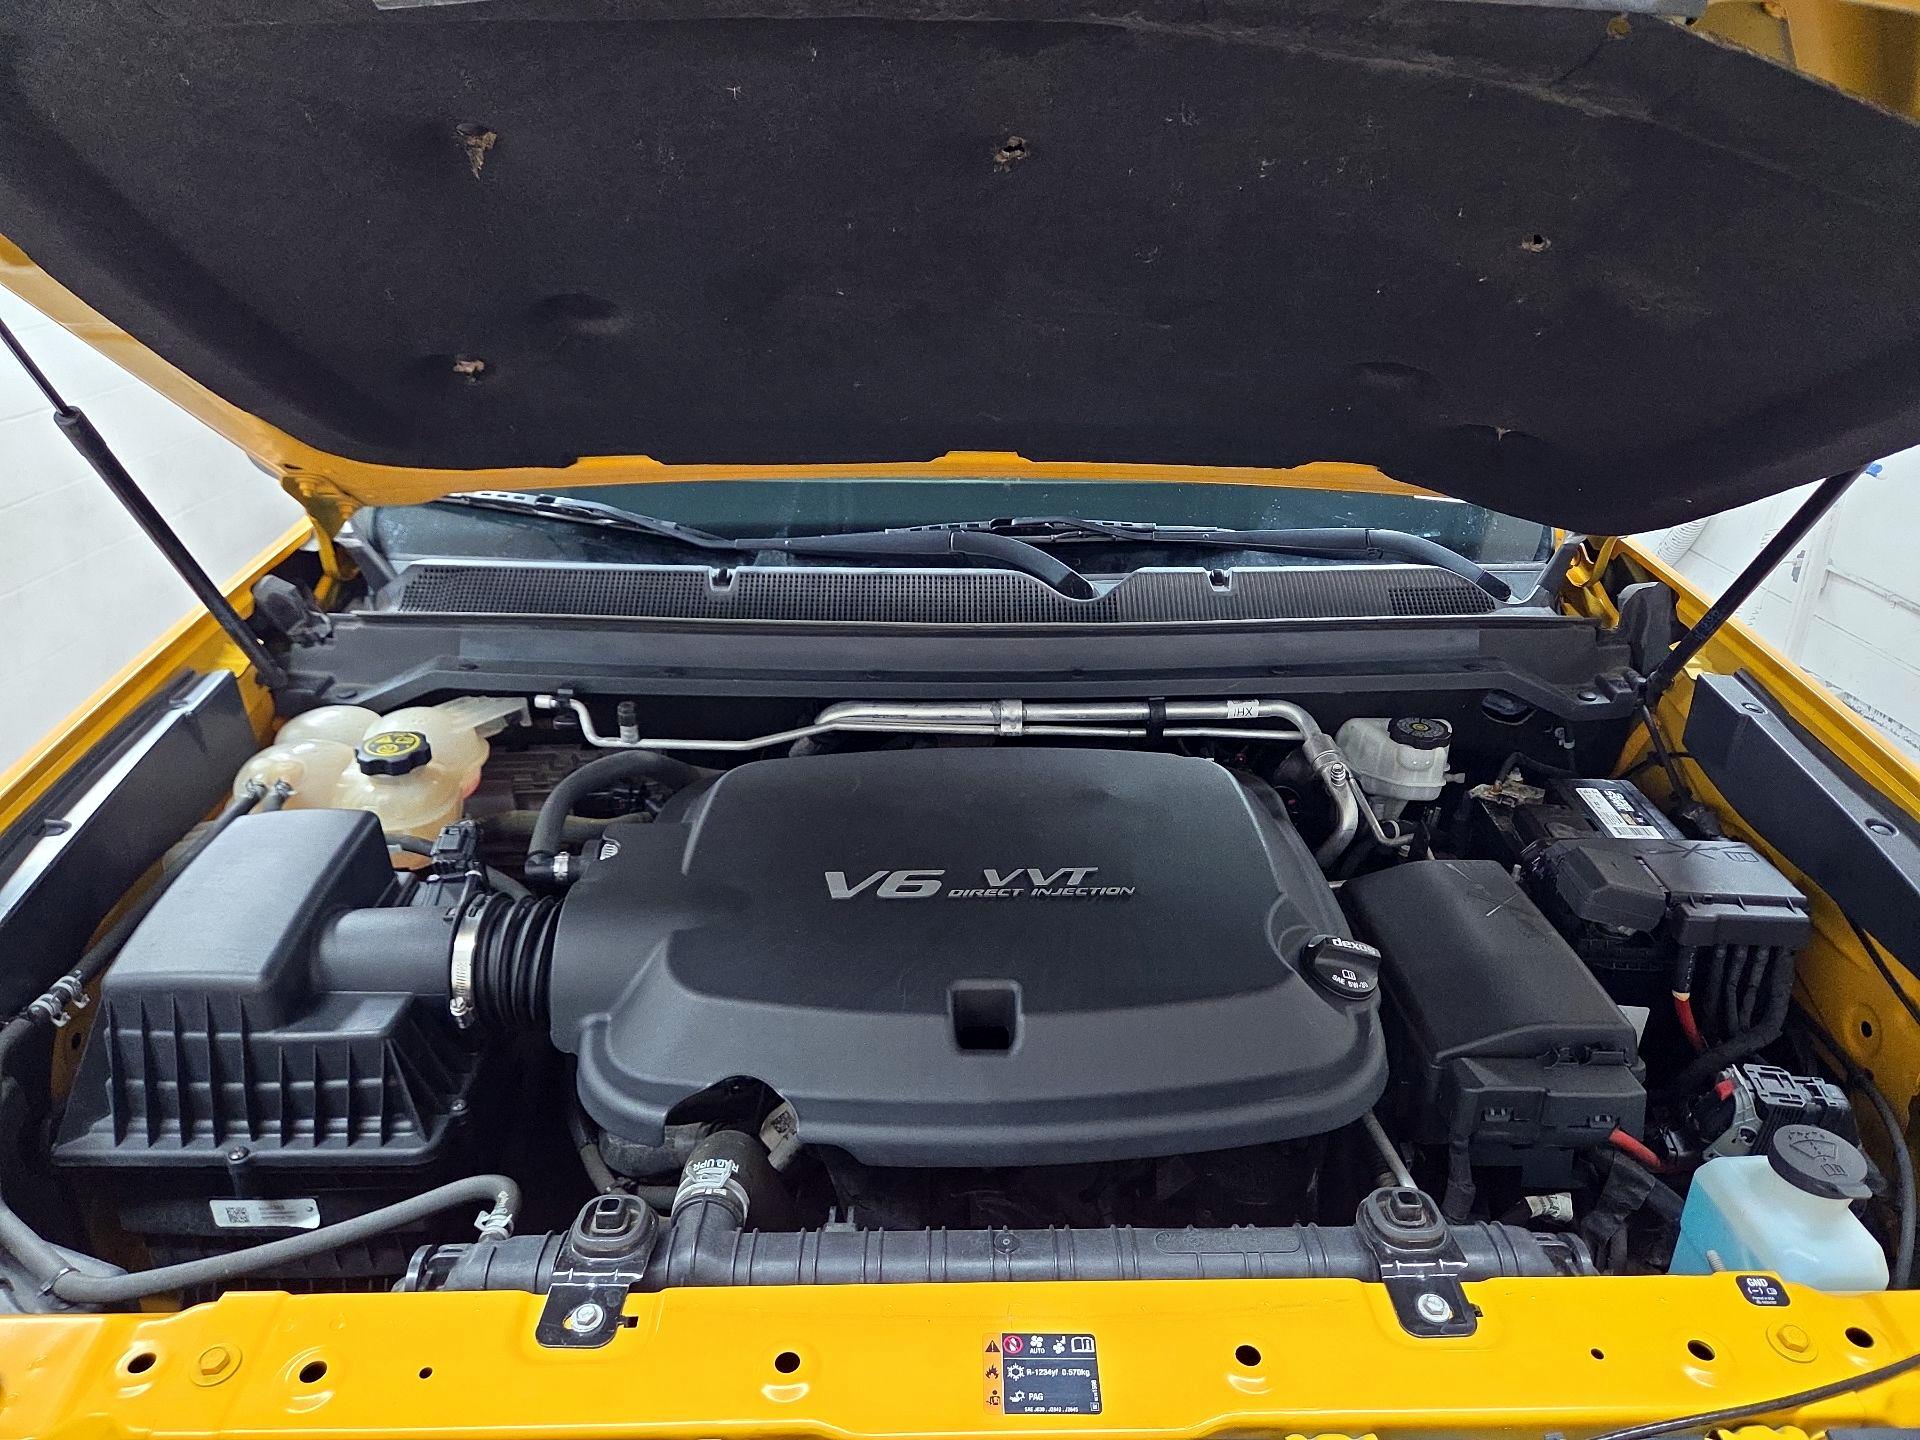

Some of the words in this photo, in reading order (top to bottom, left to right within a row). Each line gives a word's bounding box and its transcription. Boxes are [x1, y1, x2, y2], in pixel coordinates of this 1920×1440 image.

[824, 870, 945, 900] V6
[983, 866, 1099, 887] VVT
[947, 888, 1024, 898] DIRECT
[1031, 886, 1136, 897] INJECTION
[1331, 974, 1346, 985] SAE
[1746, 1277, 1769, 1287] GND
[1026, 1368, 1059, 1377] R-1234yf
[1028, 1392, 1044, 1401] PAG
